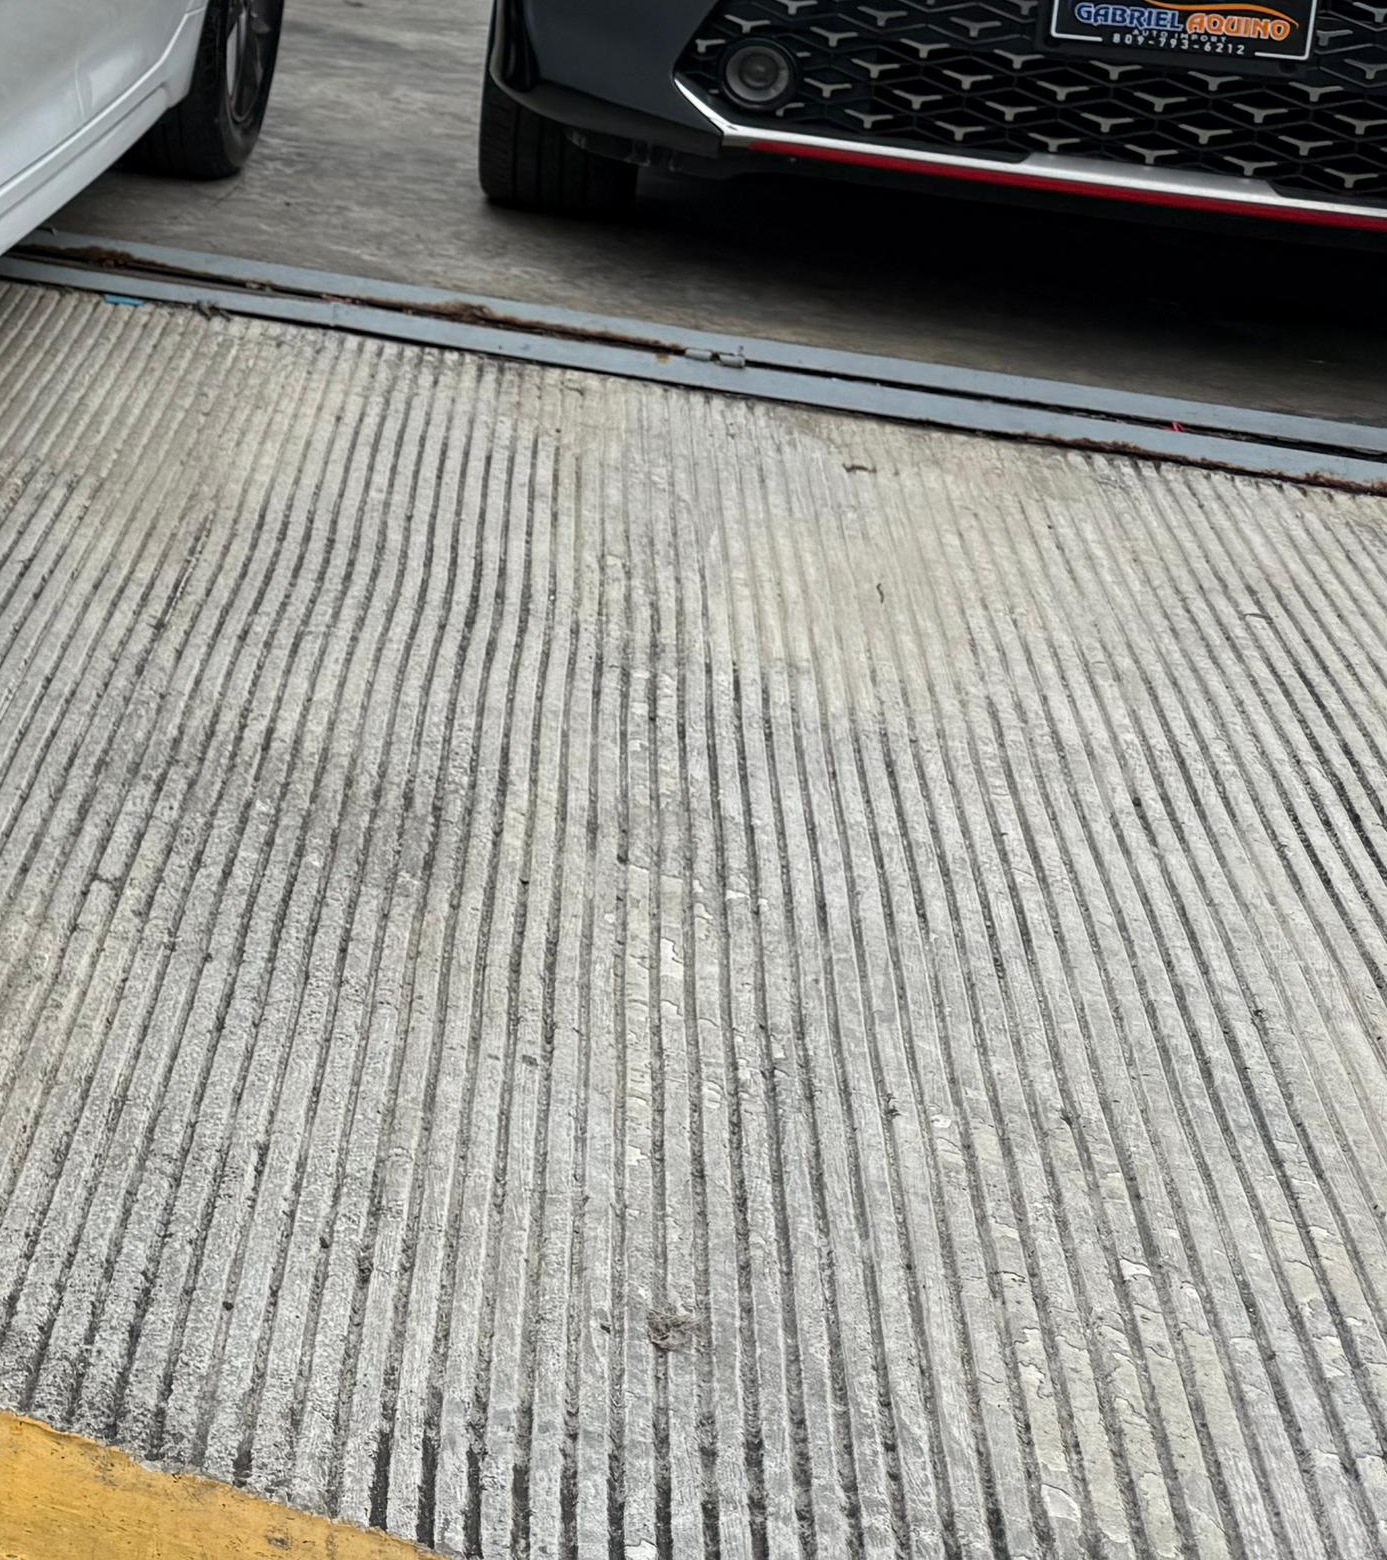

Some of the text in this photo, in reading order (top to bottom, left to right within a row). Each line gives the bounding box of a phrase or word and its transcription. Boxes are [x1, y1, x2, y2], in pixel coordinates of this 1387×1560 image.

[1075, 2, 1291, 41] GABRIEL AQUINO
[1113, 33, 1245, 55] 809-793-6212
